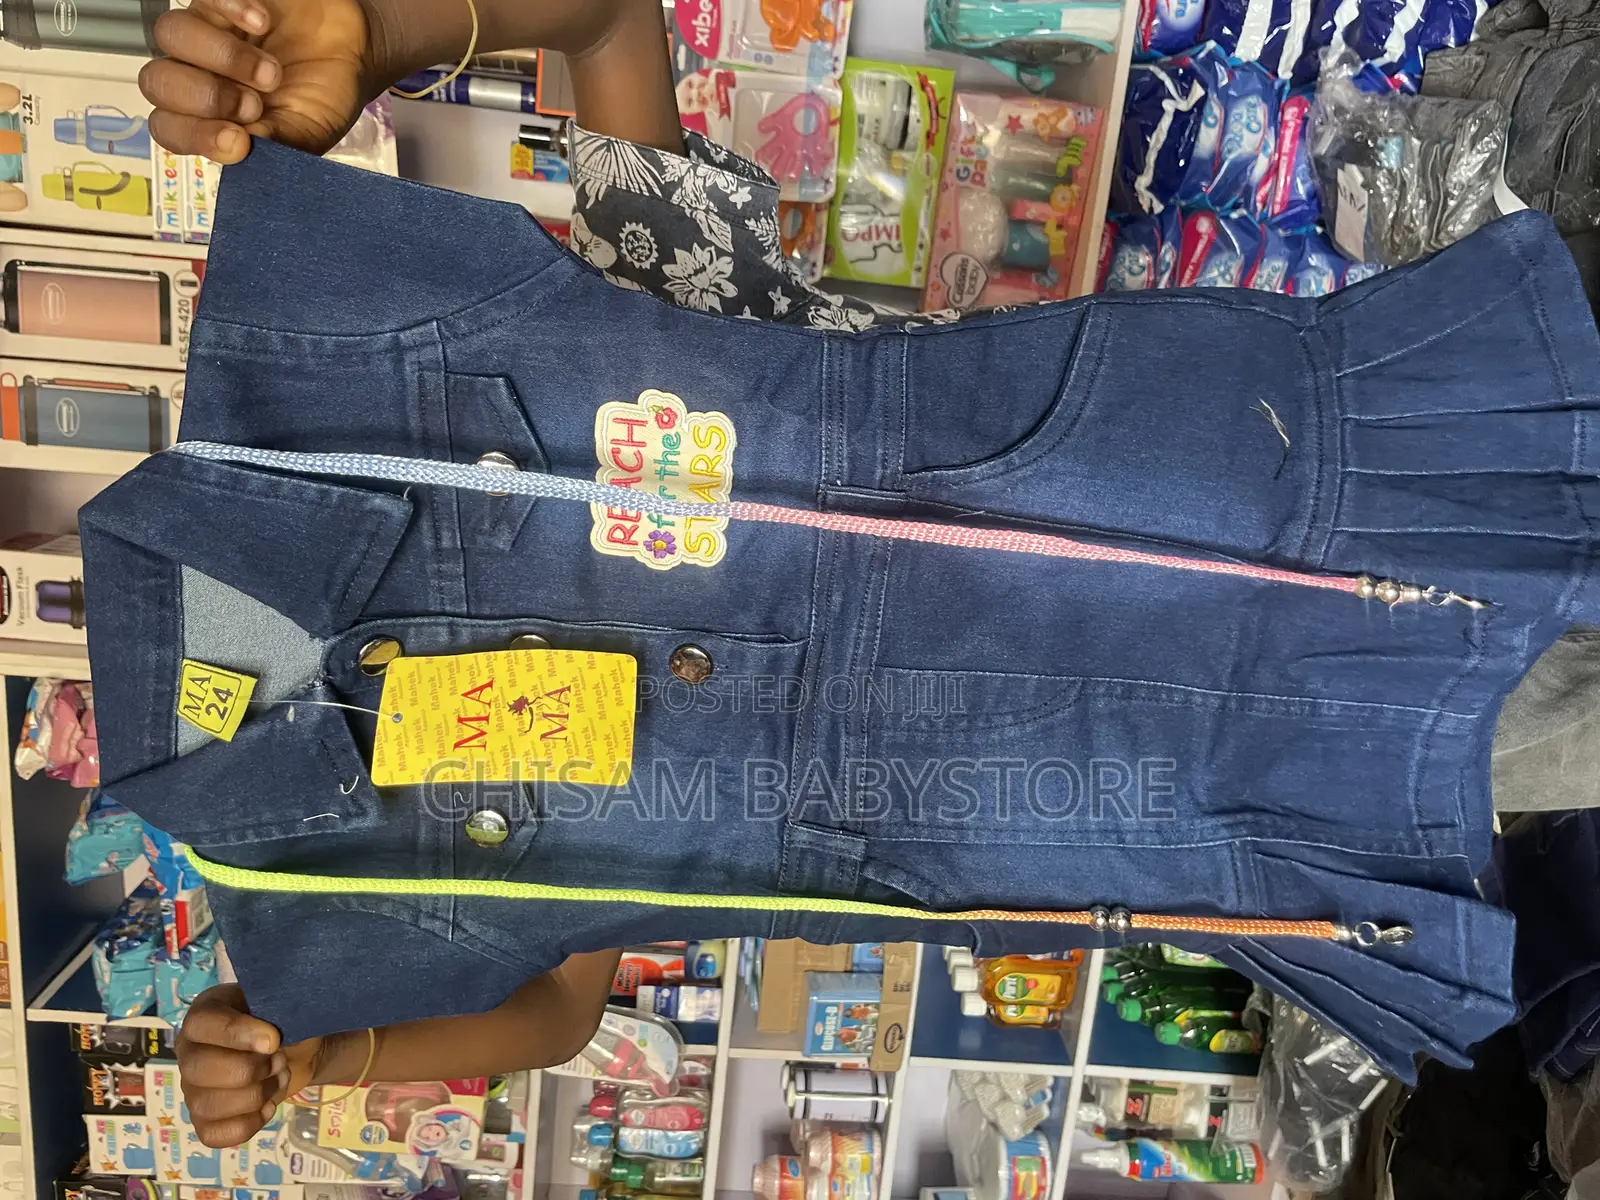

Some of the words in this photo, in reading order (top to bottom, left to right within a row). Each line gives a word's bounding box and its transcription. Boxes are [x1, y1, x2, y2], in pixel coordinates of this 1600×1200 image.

[22, 94, 33, 125] 3.2L
[955, 136, 975, 181] Gift
[164, 191, 179, 227] milk
[194, 191, 210, 227] milk
[952, 258, 968, 304] Cussons
[654, 432, 681, 481] the
[607, 418, 648, 546] REACH
[684, 425, 726, 556] STARS
[648, 486, 676, 528] fr
[16, 592, 25, 626] Vacuum
[183, 675, 212, 719] MA
[205, 687, 234, 720] 24
[453, 678, 494, 751] MA
[540, 685, 572, 742] MA
